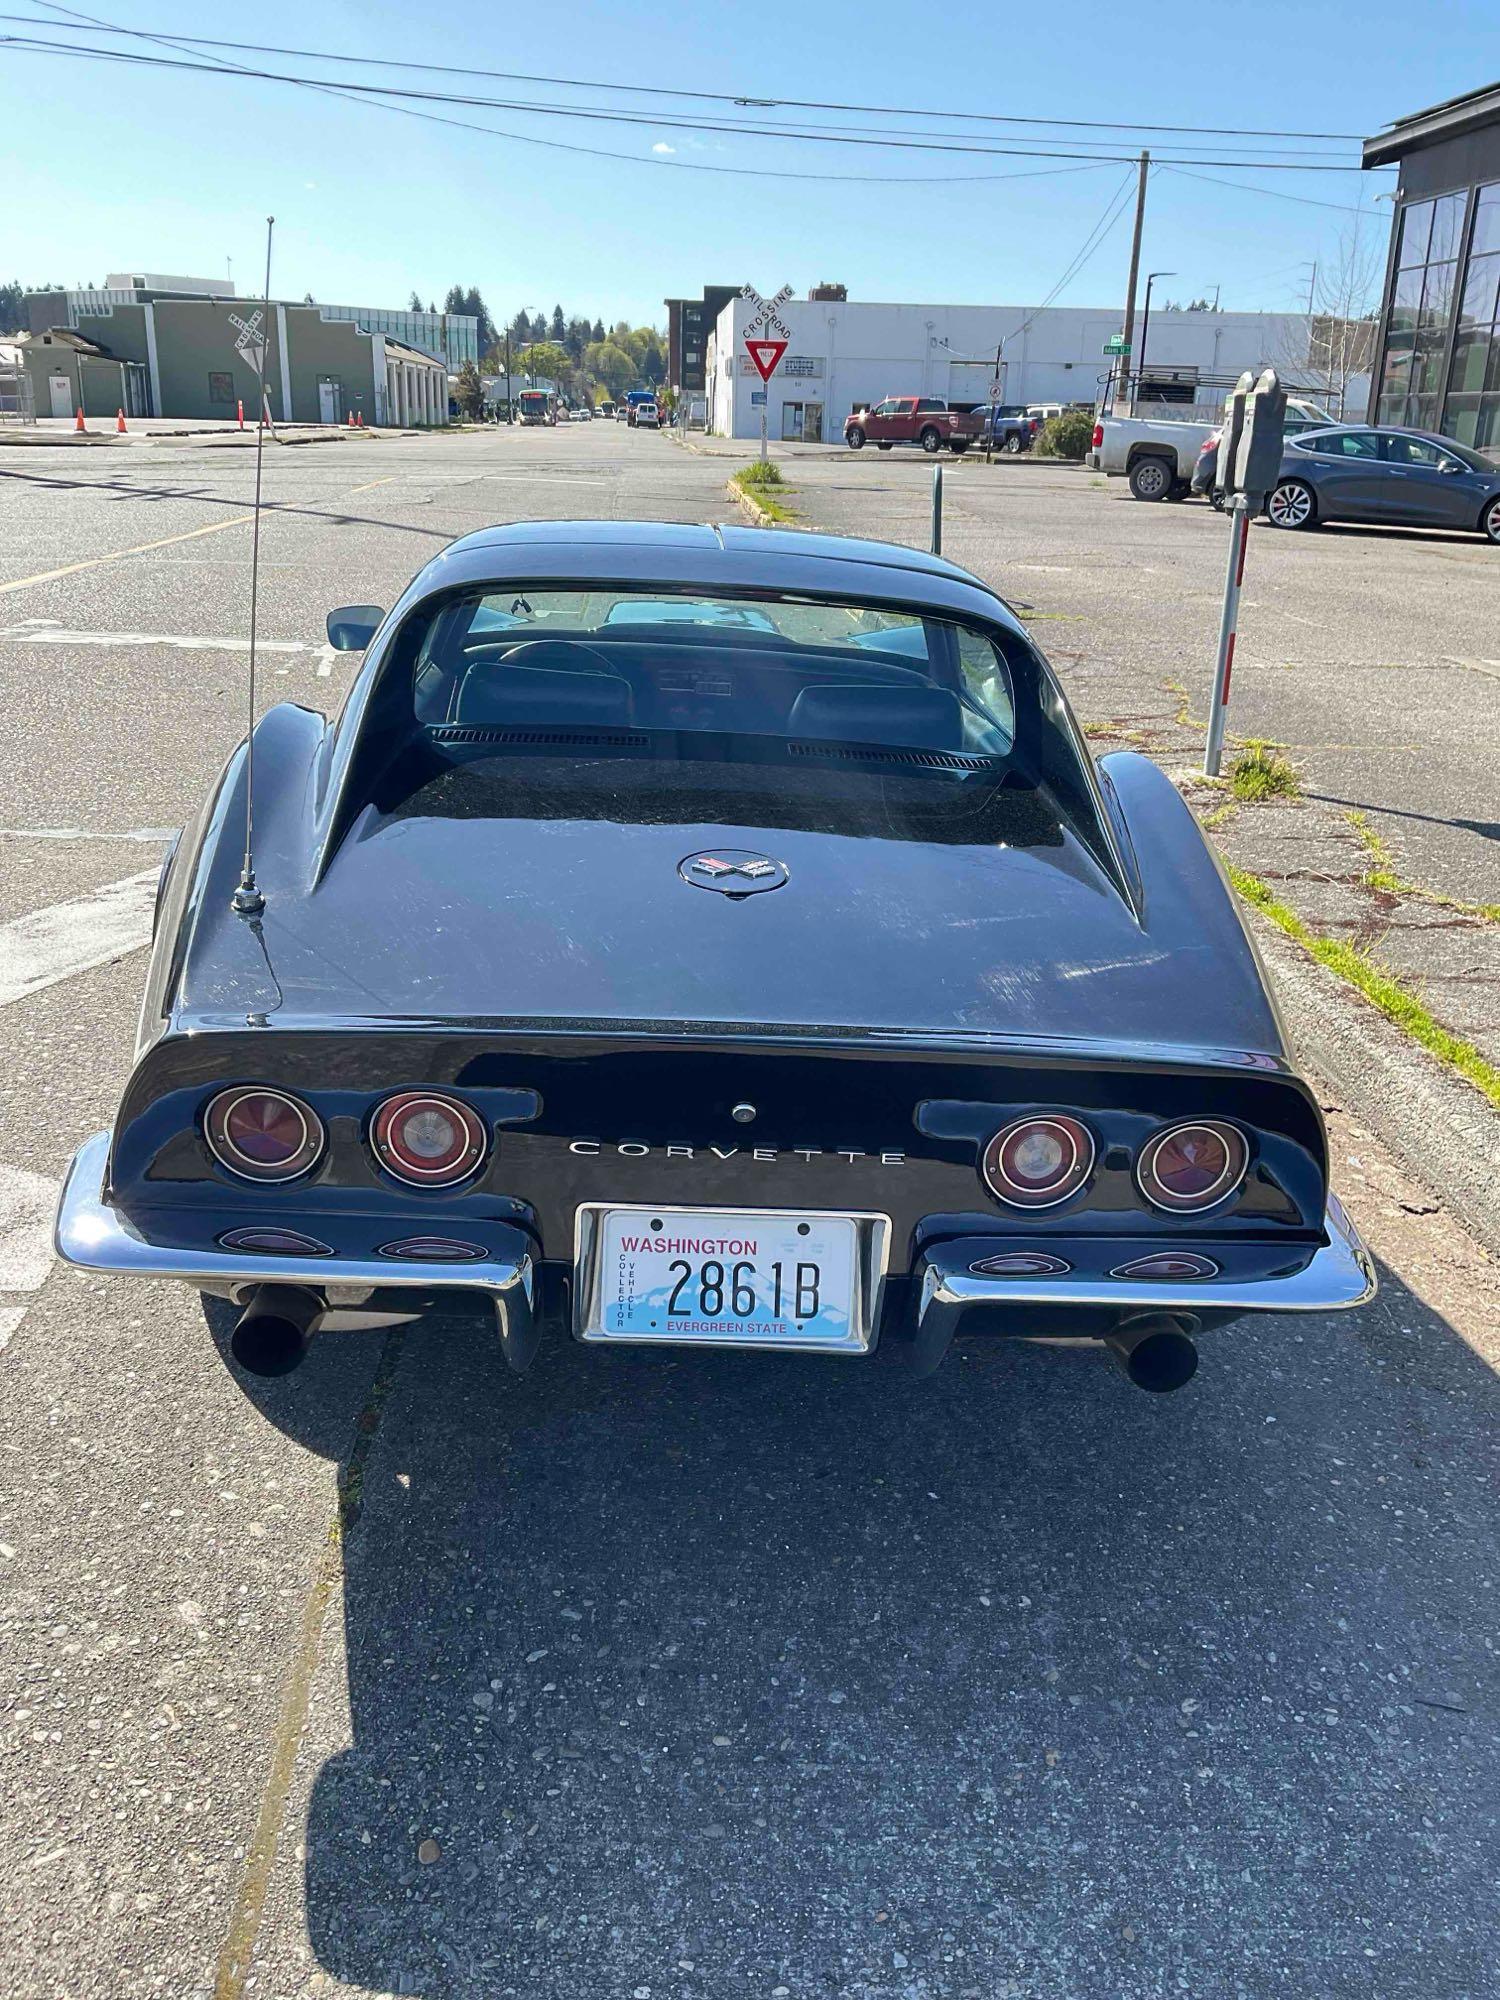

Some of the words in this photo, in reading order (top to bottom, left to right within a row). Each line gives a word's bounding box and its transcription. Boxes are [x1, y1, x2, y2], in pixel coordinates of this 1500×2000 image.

[236, 311, 262, 348] CROSSING
[742, 287, 793, 339] CROSSING
[568, 1141, 906, 1165] CORVETTE
[621, 1236, 757, 1256] WASHINGTON
[617, 1254, 626, 1327] COLLECTOR
[627, 1262, 635, 1319] VEHICLE
[667, 1259, 820, 1319] 2861B
[667, 1320, 743, 1333] EVERGREEN
[747, 1324, 787, 1334] STATE
